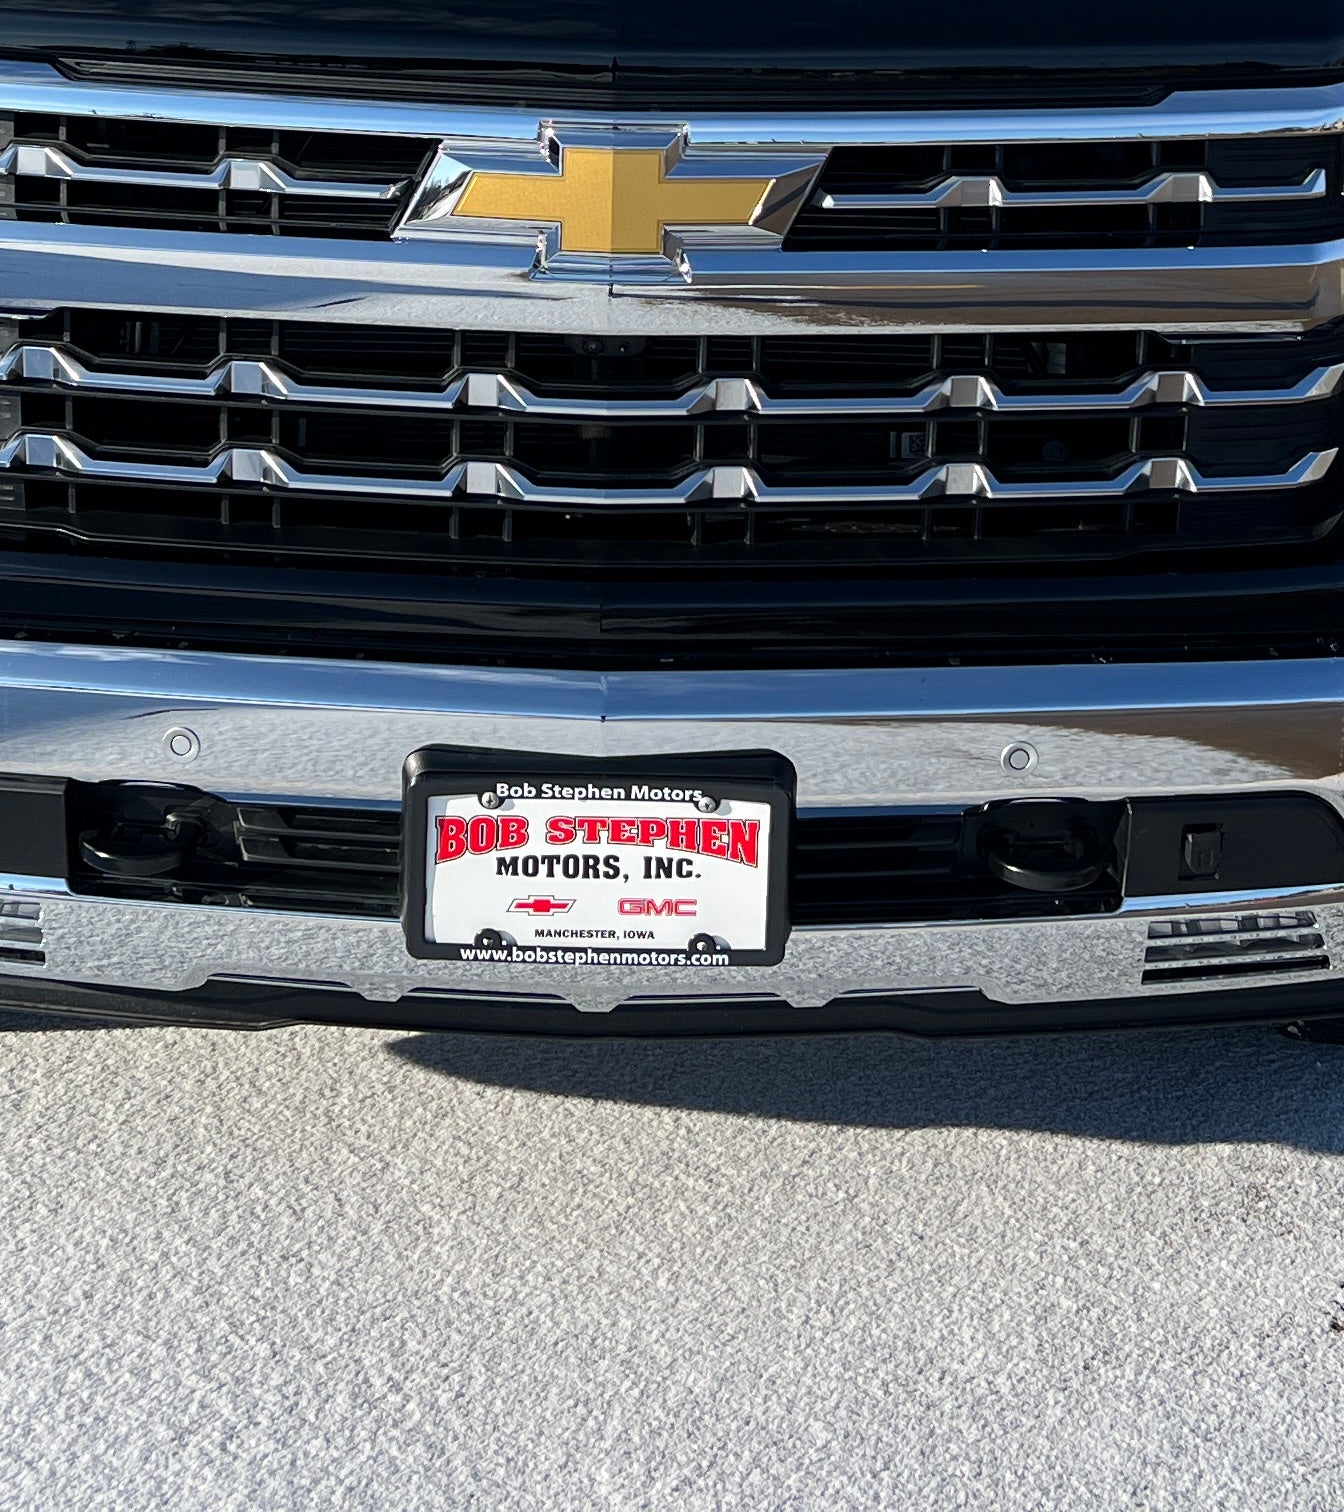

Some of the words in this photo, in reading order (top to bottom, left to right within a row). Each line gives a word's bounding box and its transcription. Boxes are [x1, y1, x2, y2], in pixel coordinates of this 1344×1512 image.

[495, 782, 537, 798] Bob
[541, 783, 625, 801] Stephen
[630, 785, 703, 801] Motors
[435, 814, 530, 865] BOB
[545, 815, 761, 868] STEPHEN
[495, 853, 629, 883] MOTORS,
[642, 855, 702, 879] INC.
[617, 897, 698, 917] GMC
[533, 928, 620, 941] MANCHESTER,
[622, 930, 655, 940] IOWA
[459, 945, 730, 967] www.bobstephenmotors.com
